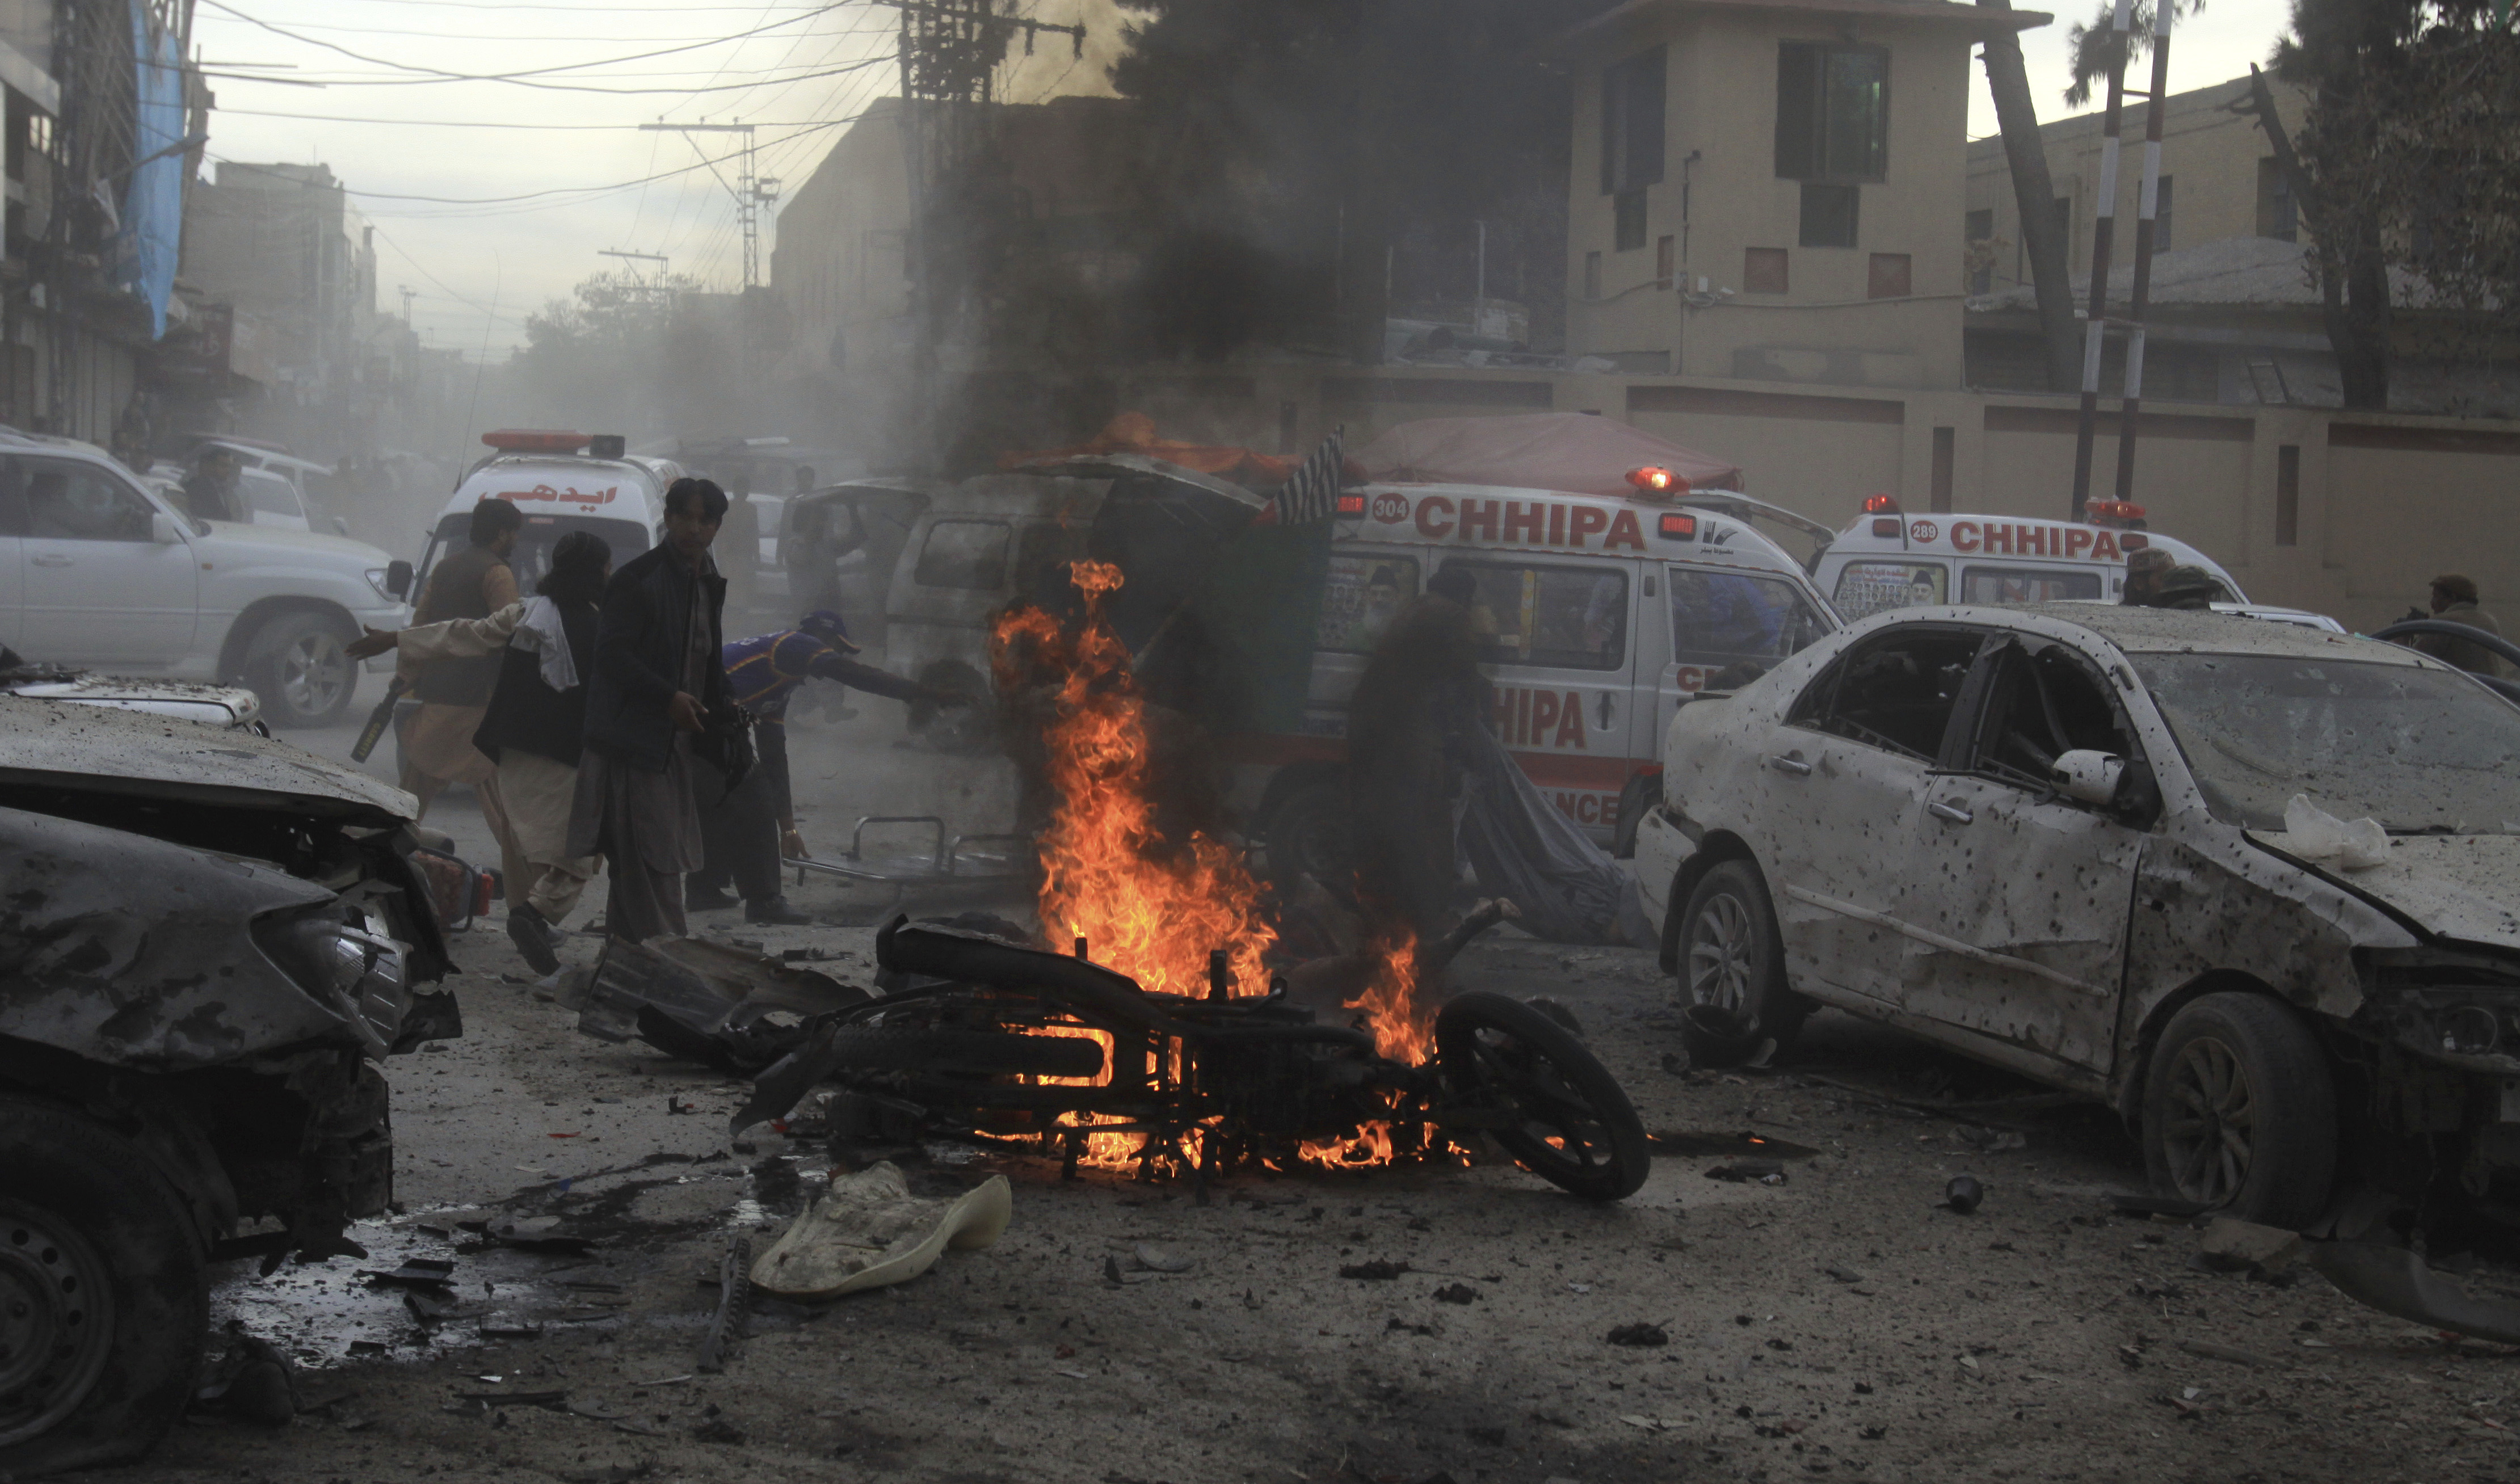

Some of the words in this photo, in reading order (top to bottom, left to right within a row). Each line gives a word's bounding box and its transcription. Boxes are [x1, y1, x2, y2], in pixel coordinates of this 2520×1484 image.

[1375, 500, 1406, 518] 304
[1415, 496, 1648, 551] CHHIPA
[1913, 525, 1937, 538] 289
[1950, 521, 2124, 562] CHHIPA
[1492, 687, 1587, 749] HIPA
[1545, 792, 1619, 825] NCE
